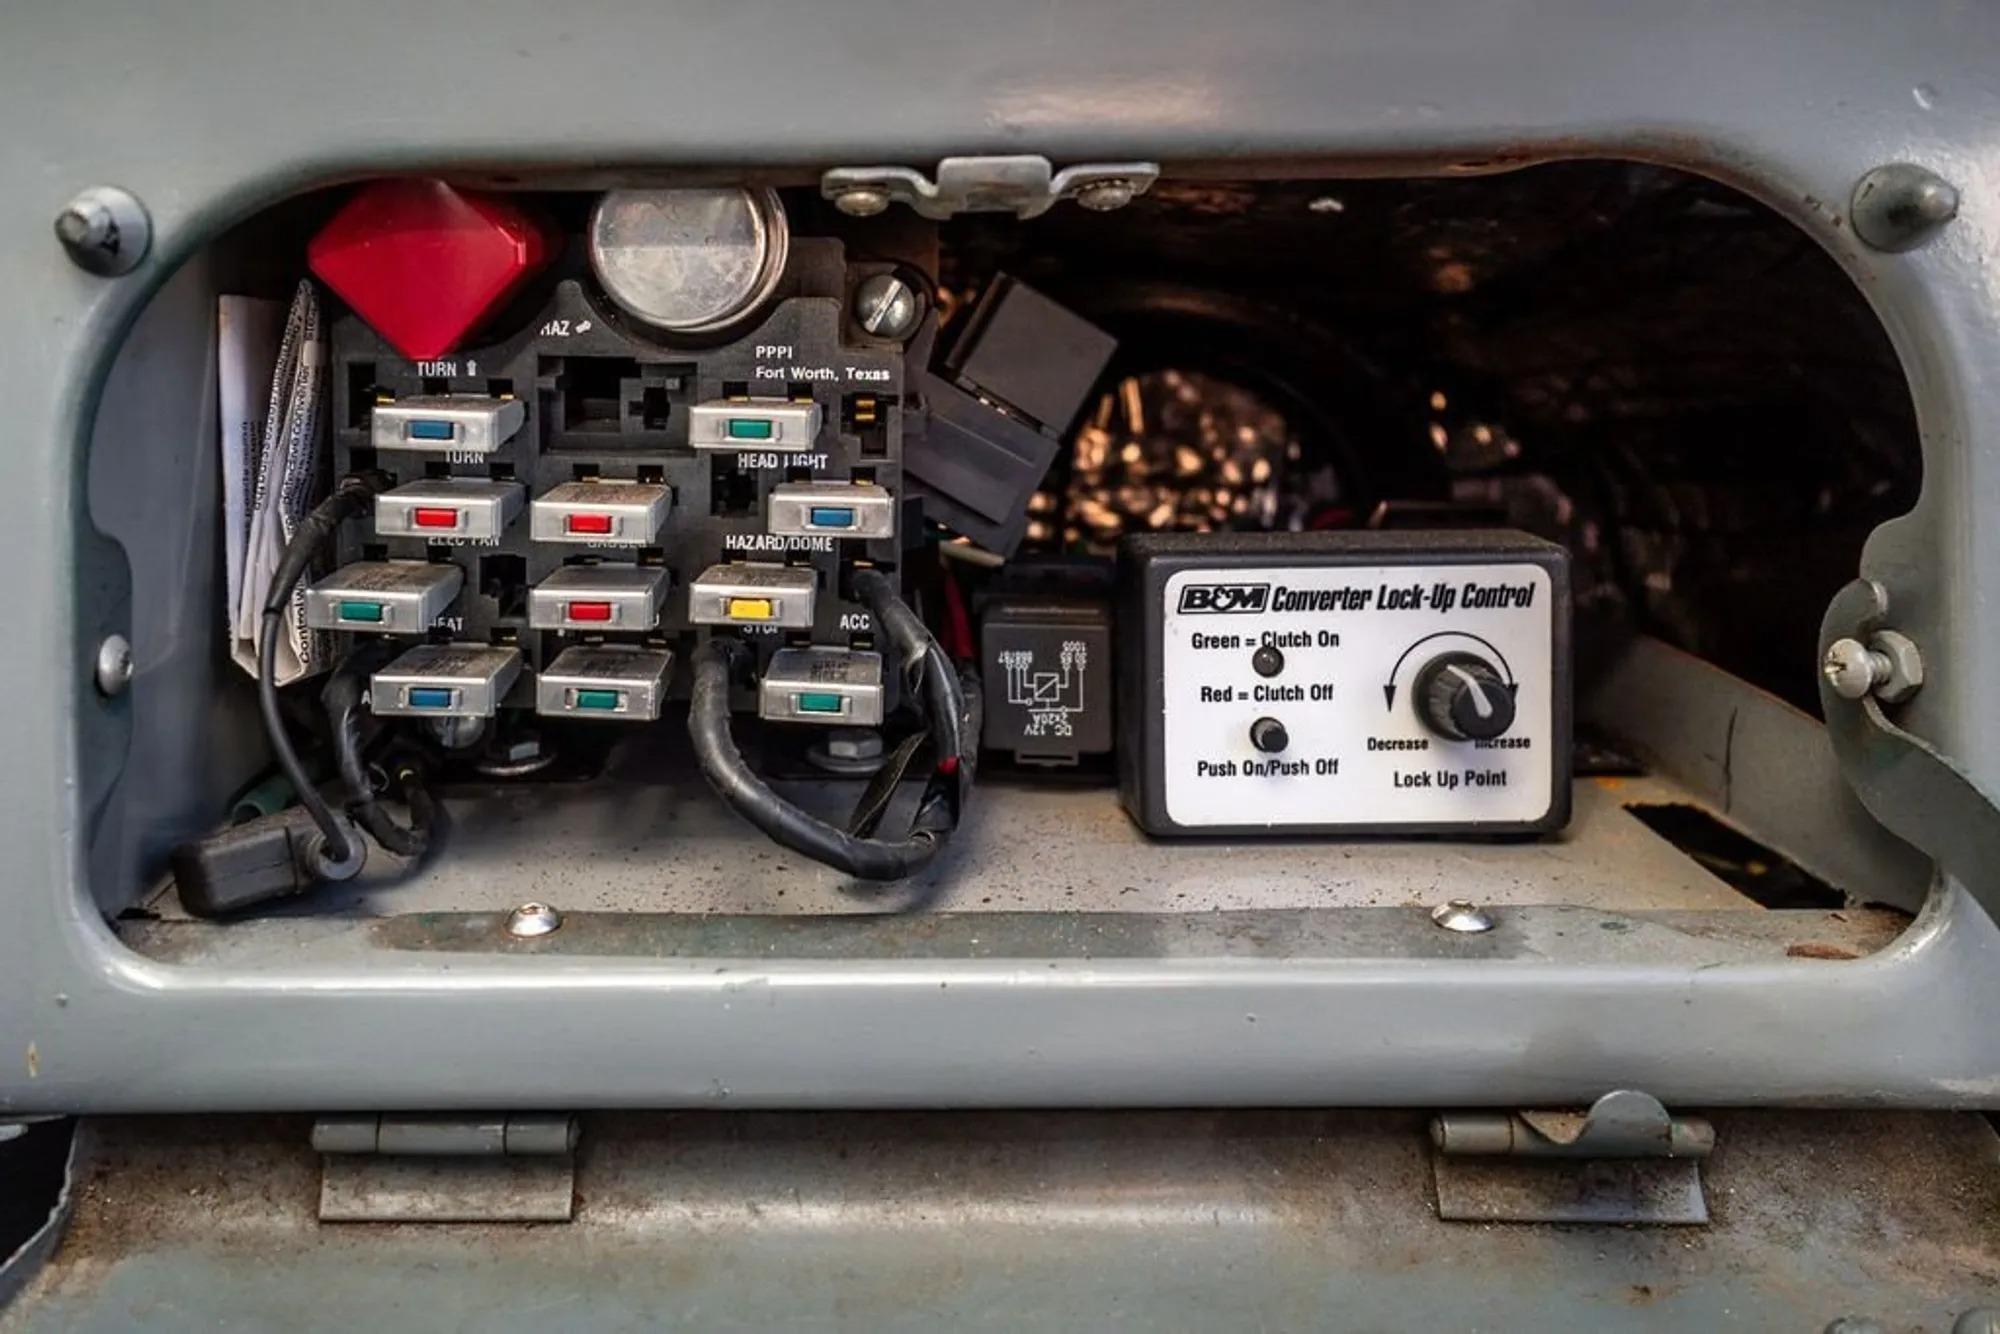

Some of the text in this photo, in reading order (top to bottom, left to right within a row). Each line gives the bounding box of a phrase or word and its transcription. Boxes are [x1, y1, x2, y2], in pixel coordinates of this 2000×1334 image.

[755, 346, 792, 359] PPPI
[416, 362, 456, 376] TURN
[755, 367, 890, 382] Fort Worth, Texas
[445, 451, 484, 464] TURN
[738, 453, 779, 468] HEAD
[726, 535, 833, 551] HAZARD/DOME
[1183, 582, 1536, 614] B&M Converter Lock-Up Control
[840, 614, 871, 630] ACC
[1191, 633, 1240, 649] Green
[1261, 631, 1312, 648] Clutch
[1318, 631, 1339, 647] On
[1201, 686, 1233, 702] Red
[1254, 684, 1304, 701] Clutch
[1310, 684, 1333, 700] Off
[1024, 724, 1073, 736] DC 12V
[1367, 737, 1428, 751] Decrease
[1197, 759, 1338, 777] Push On/Push Off
[1394, 769, 1507, 790] Lock Up Point
